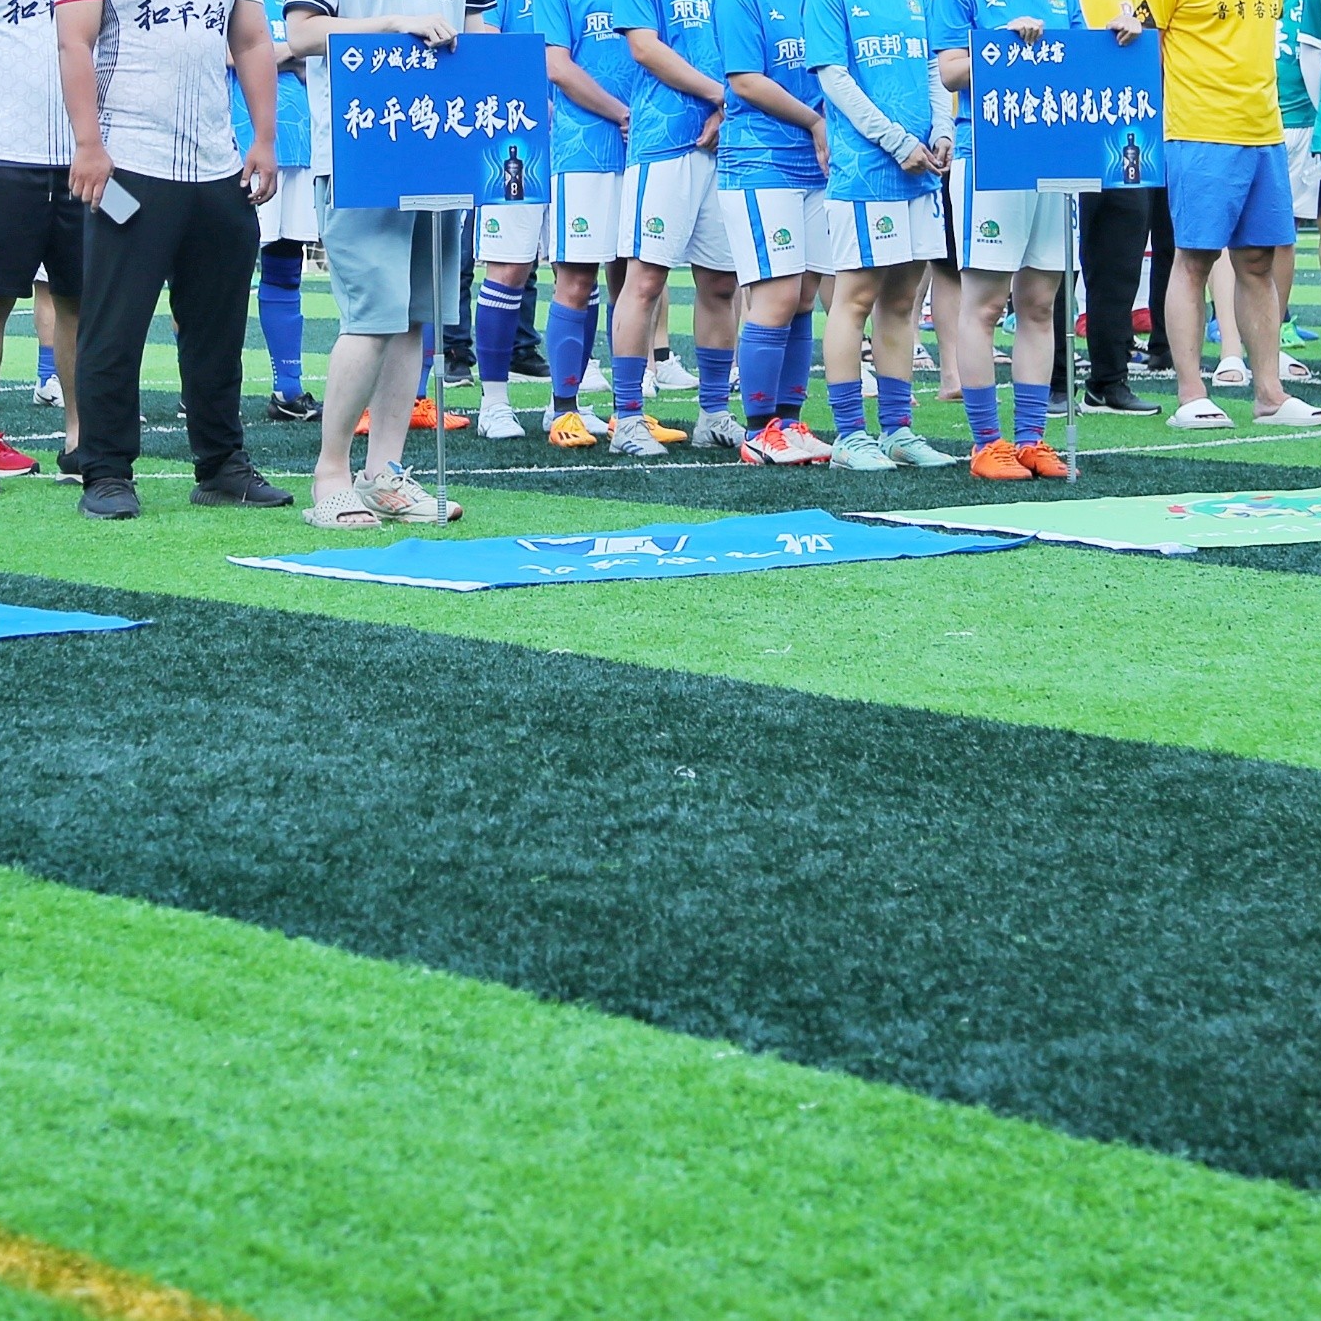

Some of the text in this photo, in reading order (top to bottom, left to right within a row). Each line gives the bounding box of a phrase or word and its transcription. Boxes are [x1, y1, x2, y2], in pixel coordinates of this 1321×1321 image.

[370, 44, 438, 74] 沙城老窖
[1006, 40, 1066, 67] 沙城老窖
[343, 94, 538, 142] 和平鸽足球队
[982, 85, 1157, 129] 丽邦金泰阳光足球队
